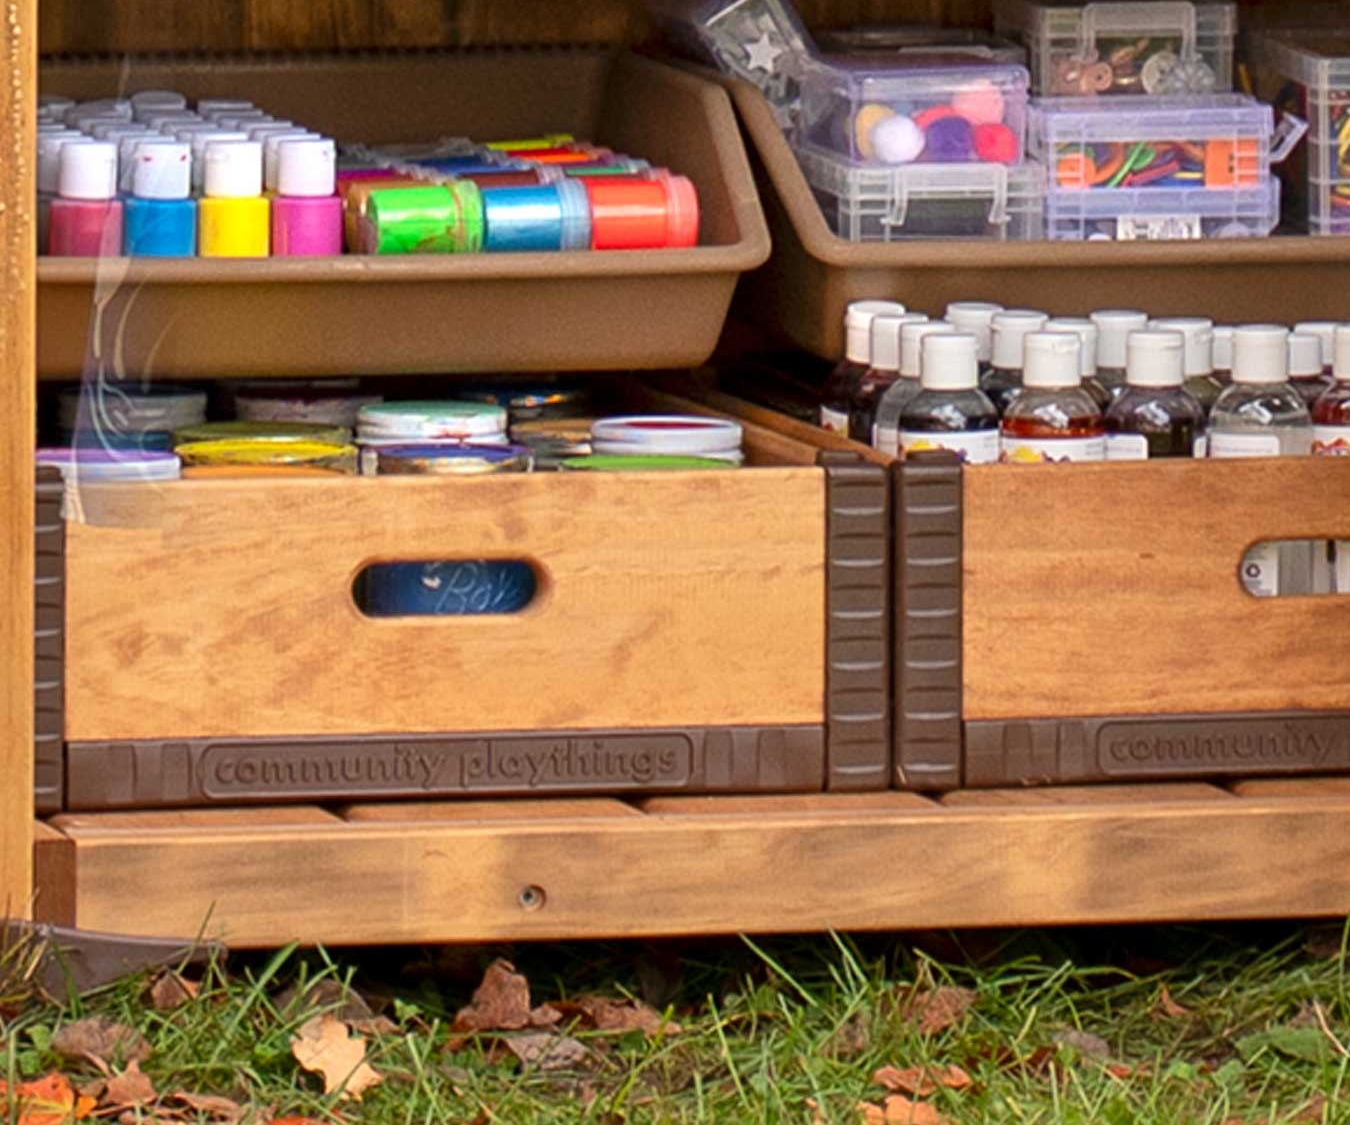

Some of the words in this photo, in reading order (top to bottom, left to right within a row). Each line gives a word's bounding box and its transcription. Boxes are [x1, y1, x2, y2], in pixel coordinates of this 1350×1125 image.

[213, 744, 447, 790] community
[460, 739, 677, 788] playthings
[1110, 722, 1331, 765] community
